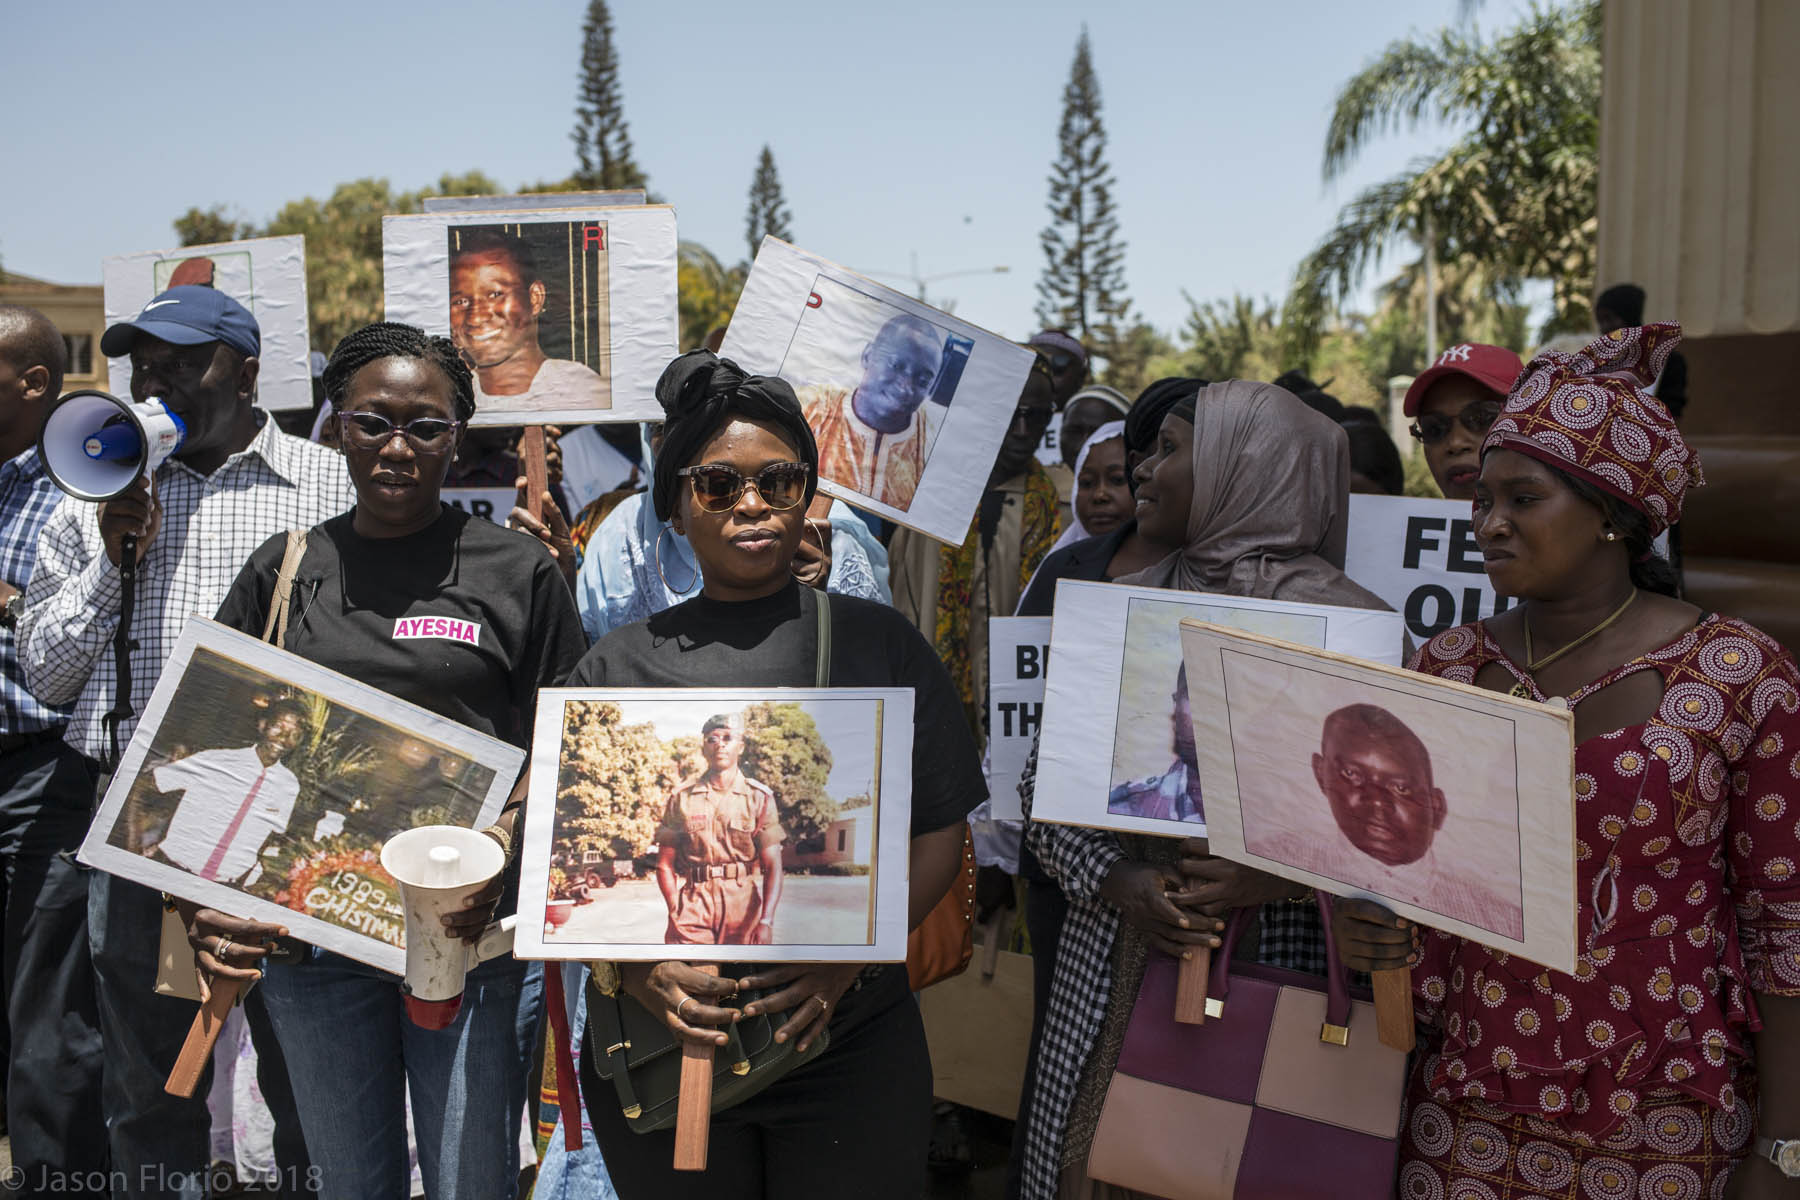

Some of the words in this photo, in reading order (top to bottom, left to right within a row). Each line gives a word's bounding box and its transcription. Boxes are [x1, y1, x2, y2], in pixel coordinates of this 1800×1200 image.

[584, 226, 604, 251] R
[1044, 429, 1057, 449] E
[1403, 516, 1488, 574] FE
[1404, 584, 1509, 639] OU
[395, 619, 475, 643] AYESHA
[998, 702, 1043, 737] TH
